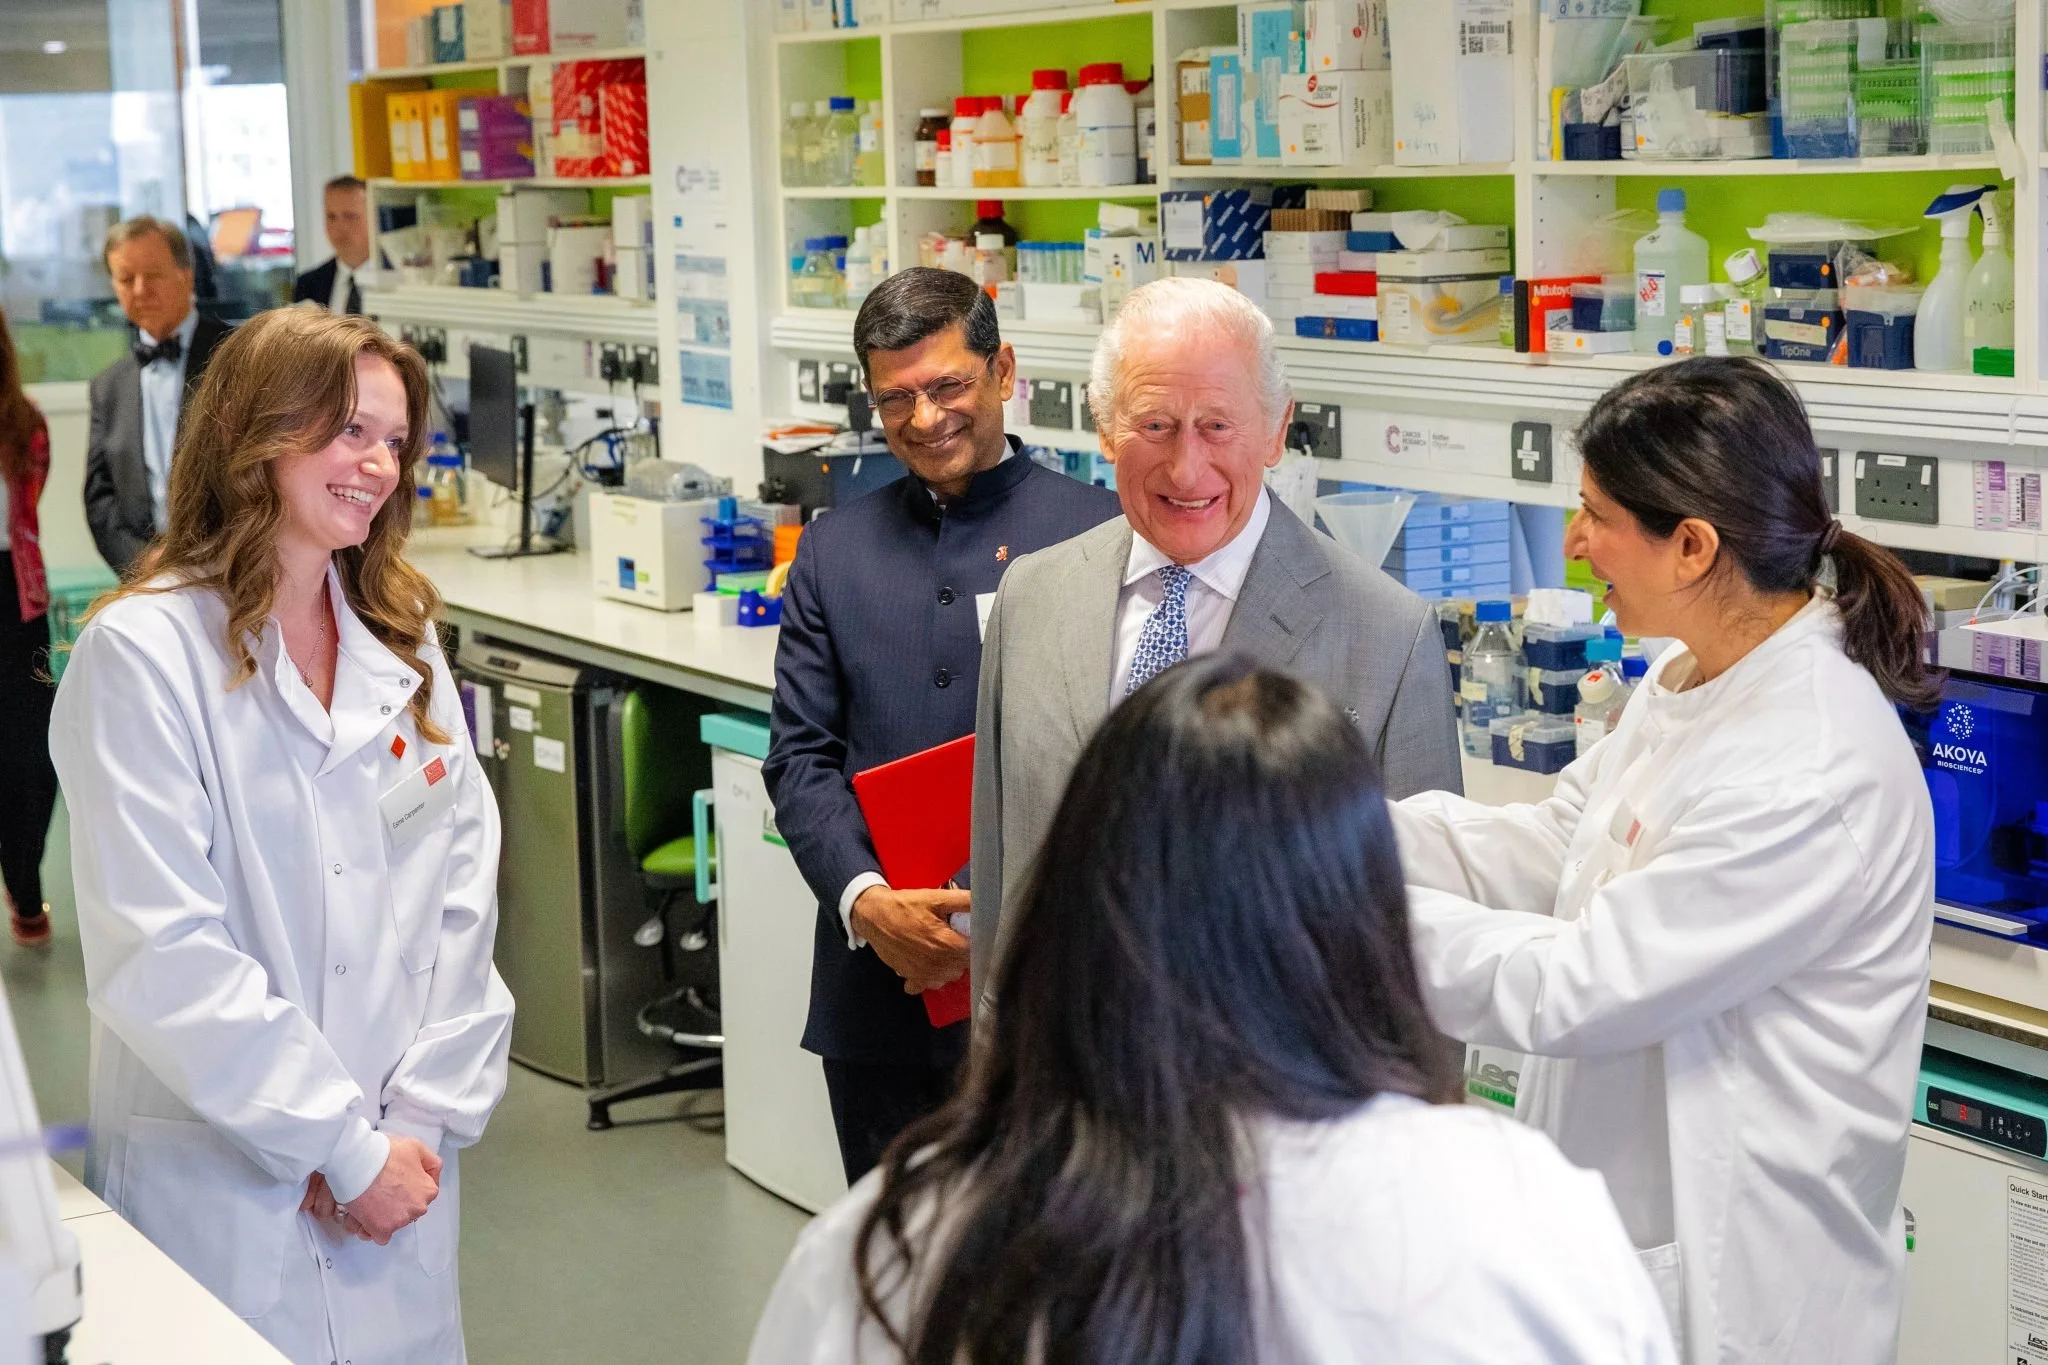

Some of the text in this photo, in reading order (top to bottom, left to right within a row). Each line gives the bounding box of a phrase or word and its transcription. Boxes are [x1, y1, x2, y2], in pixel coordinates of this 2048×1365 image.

[1780, 345, 1811, 358] TipOne
[1933, 742, 1988, 767] AKOYA
[392, 802, 425, 830] Esme Carpenter
[2010, 1184, 2048, 1201] Quick Start
